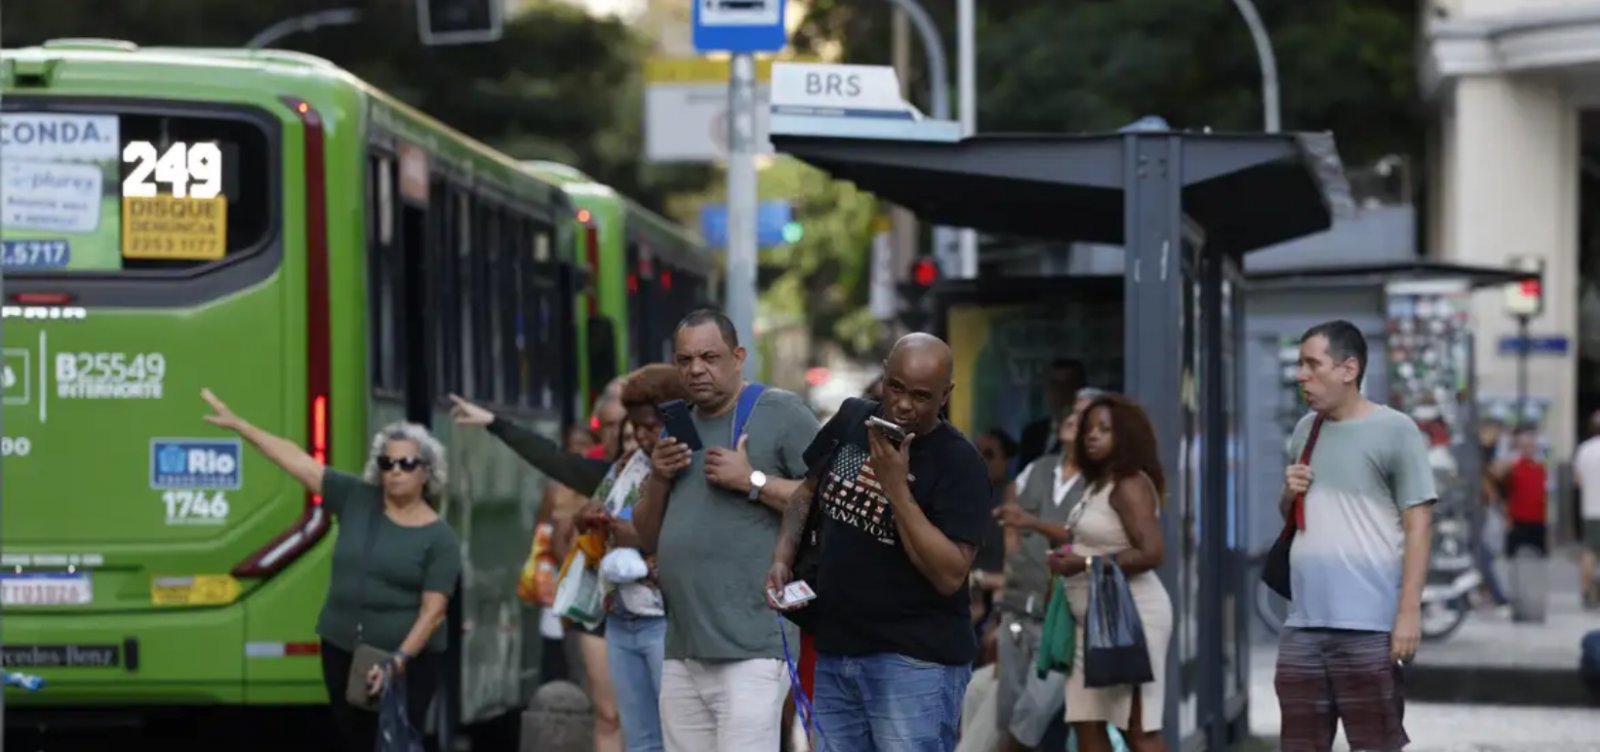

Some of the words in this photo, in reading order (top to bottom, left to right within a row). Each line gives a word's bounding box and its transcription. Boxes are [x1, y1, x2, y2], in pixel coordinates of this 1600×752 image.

[805, 72, 861, 97] BRS
[123, 141, 222, 199] 249
[130, 199, 216, 218] DISQUE
[55, 352, 165, 383] B25549
[57, 381, 163, 399] INTERNORTE
[187, 449, 235, 474] Rio
[162, 490, 230, 519] 1746
